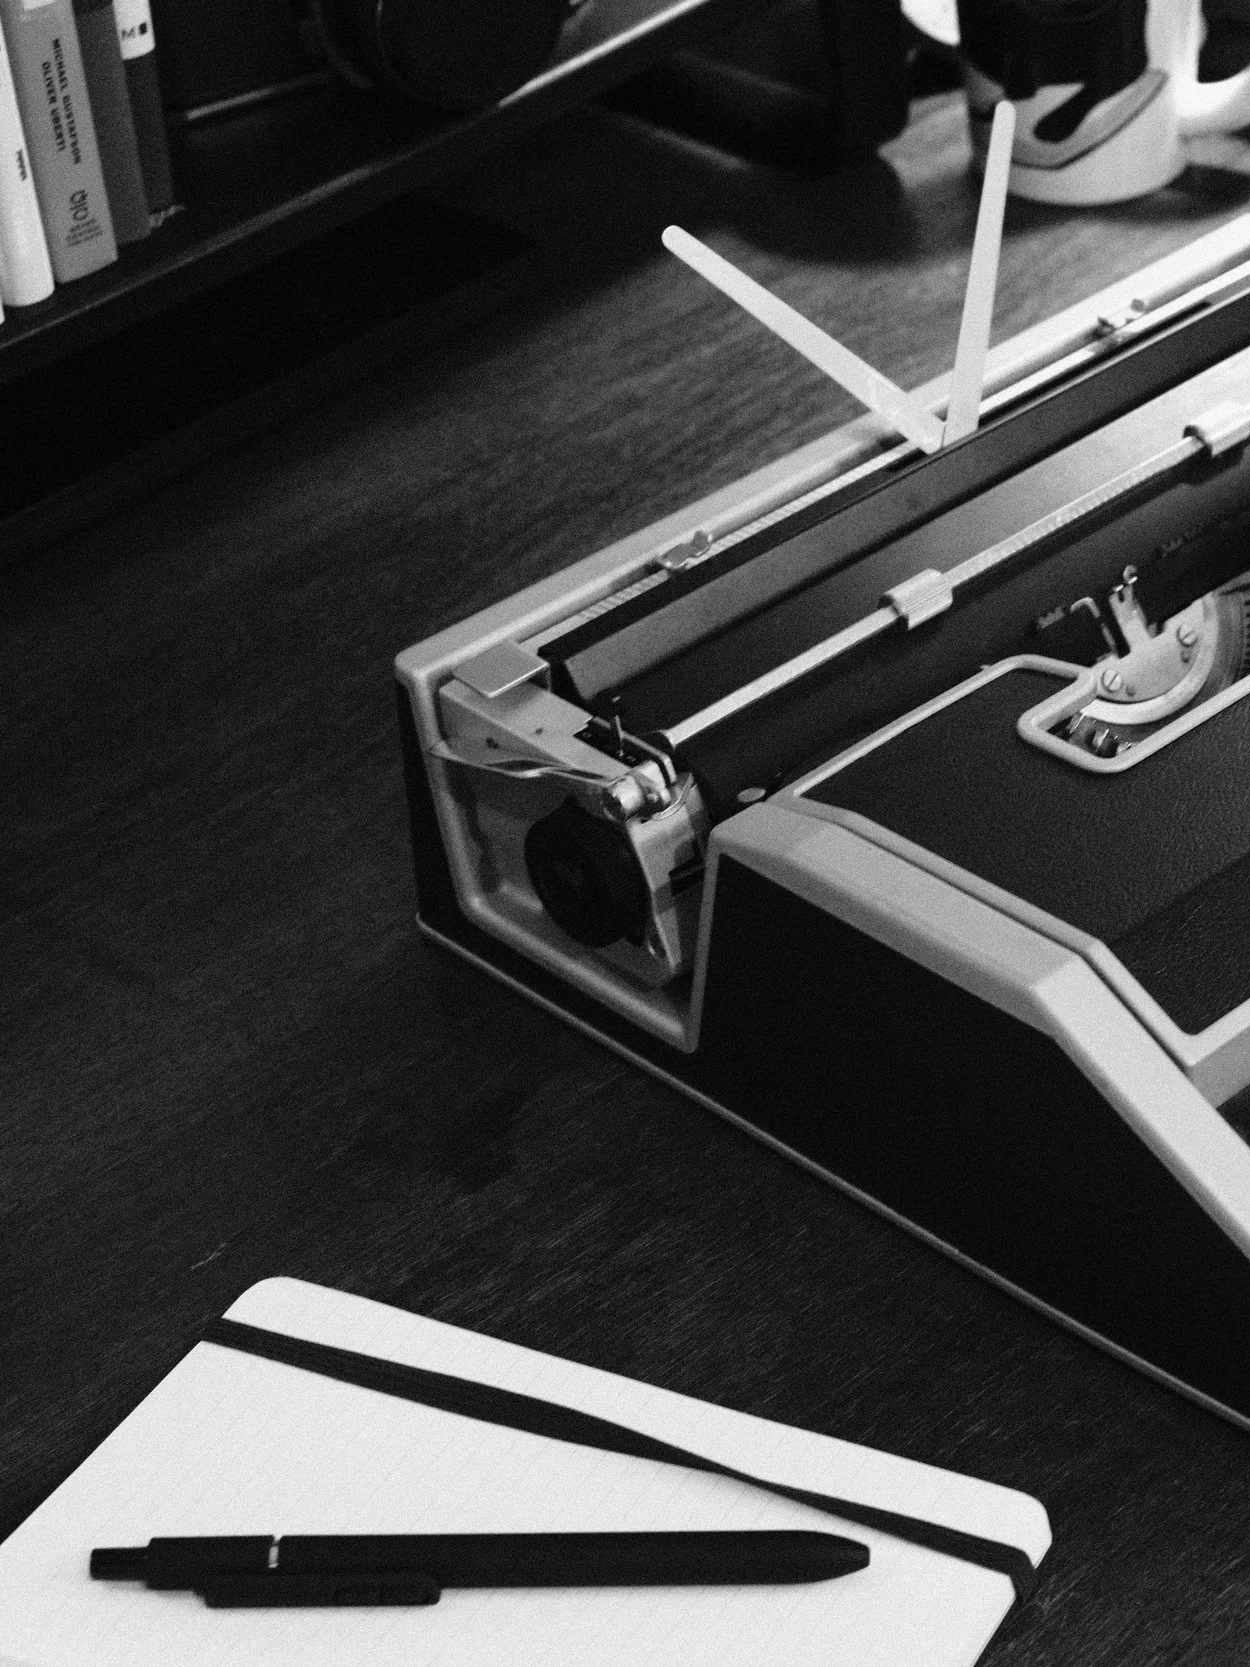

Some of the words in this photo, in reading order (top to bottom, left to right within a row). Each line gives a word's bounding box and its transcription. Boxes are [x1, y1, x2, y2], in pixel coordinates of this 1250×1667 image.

[52, 38, 68, 92] MICHAEL
[42, 61, 57, 105] OLIVER
[51, 108, 66, 153] UBERTI
